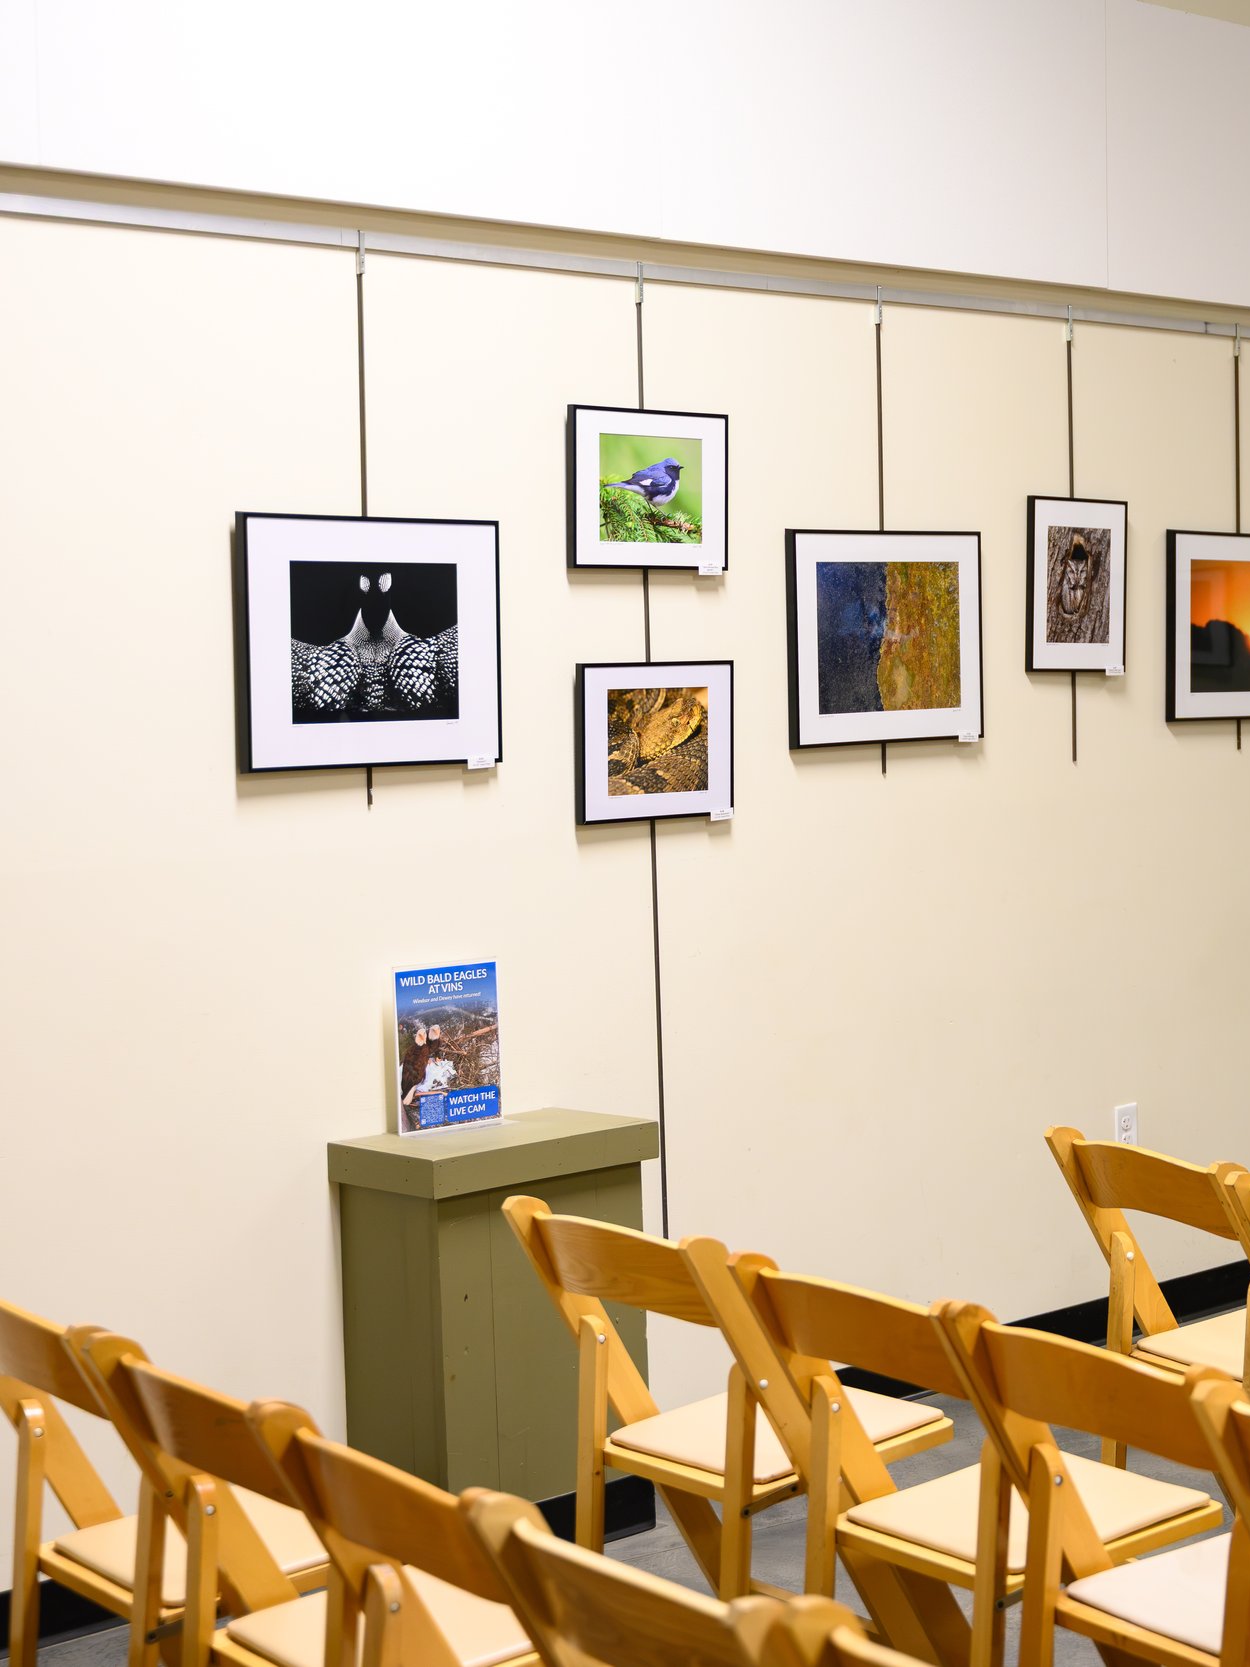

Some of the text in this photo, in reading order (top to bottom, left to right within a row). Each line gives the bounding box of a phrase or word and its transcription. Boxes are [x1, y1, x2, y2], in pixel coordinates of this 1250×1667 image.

[400, 968, 487, 987] WILD BALD EAGLES
[428, 982, 463, 994] AT VINS
[449, 1091, 496, 1105] WATCH THE
[449, 1103, 486, 1117] LIVE CAM
